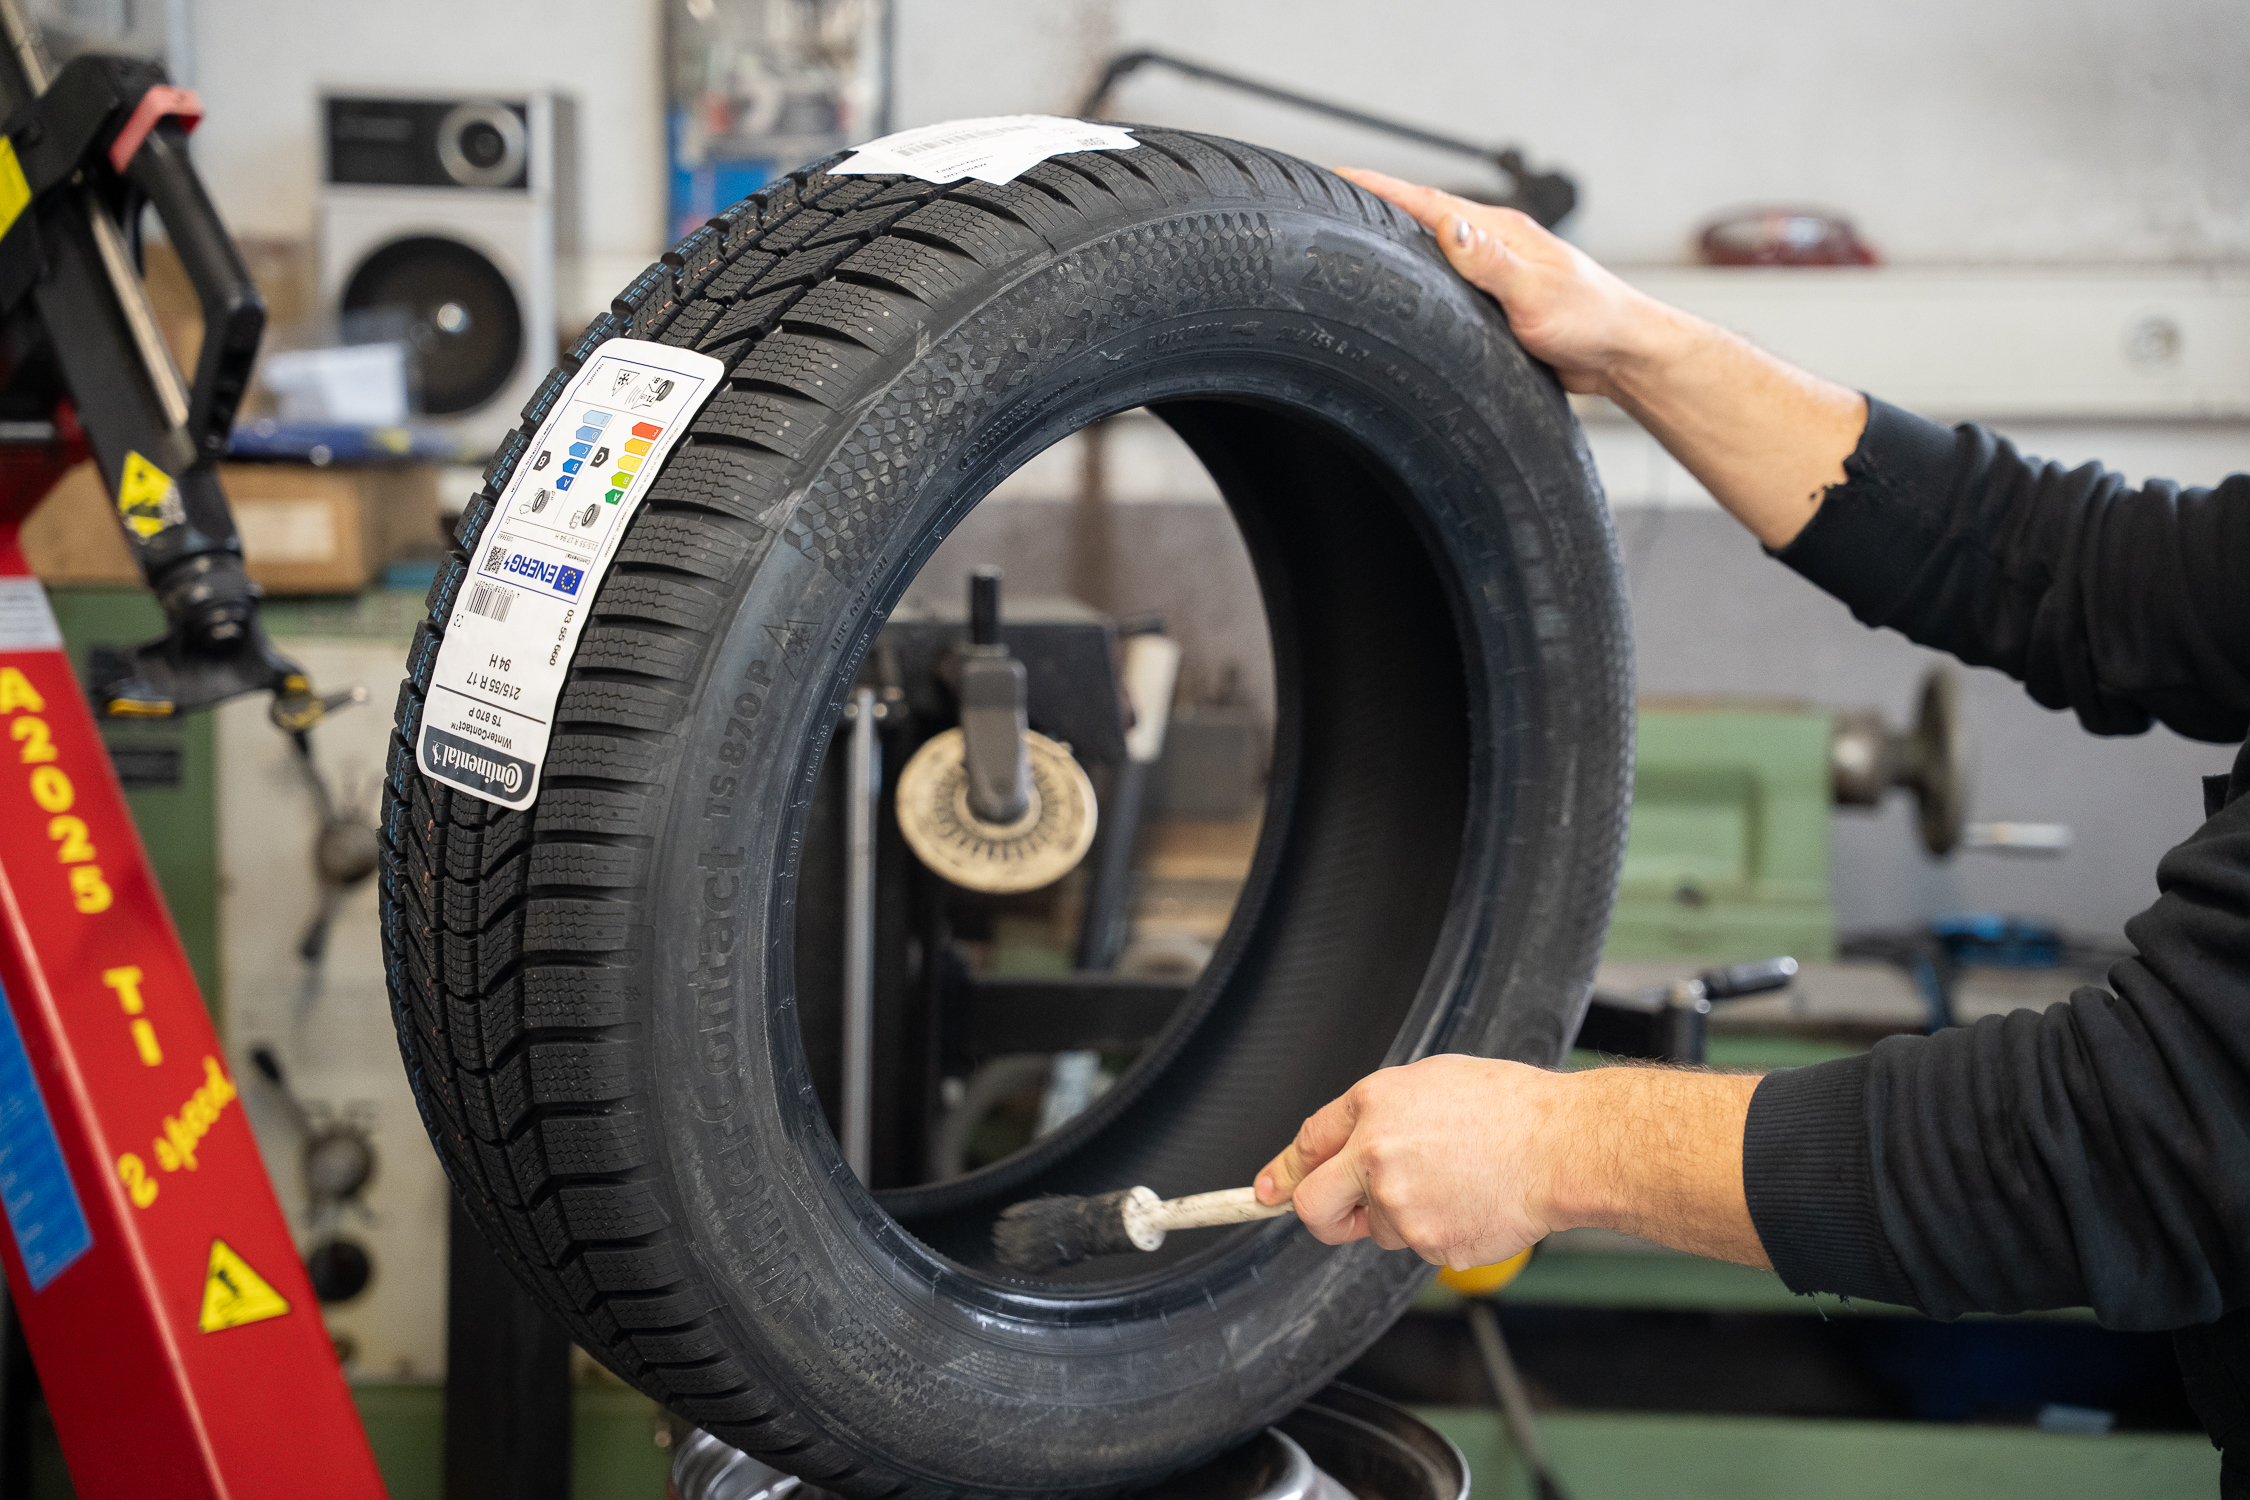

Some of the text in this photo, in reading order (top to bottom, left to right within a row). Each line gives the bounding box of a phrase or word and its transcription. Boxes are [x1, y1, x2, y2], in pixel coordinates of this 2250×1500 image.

[537, 454, 547, 467] B
[594, 450, 605, 463] C
[578, 539, 599, 551] 215/55
[564, 552, 591, 565] Continental
[548, 609, 574, 666] 03 55 660
[488, 653, 511, 672] 94 H
[465, 670, 522, 700] 215/55 R 17
[467, 706, 502, 727] TS 870 P
[702, 658, 771, 819] TS 870 P
[442, 744, 522, 793] Continental
[690, 845, 817, 1328] WinterContact
[118, 1153, 156, 1209] 2
